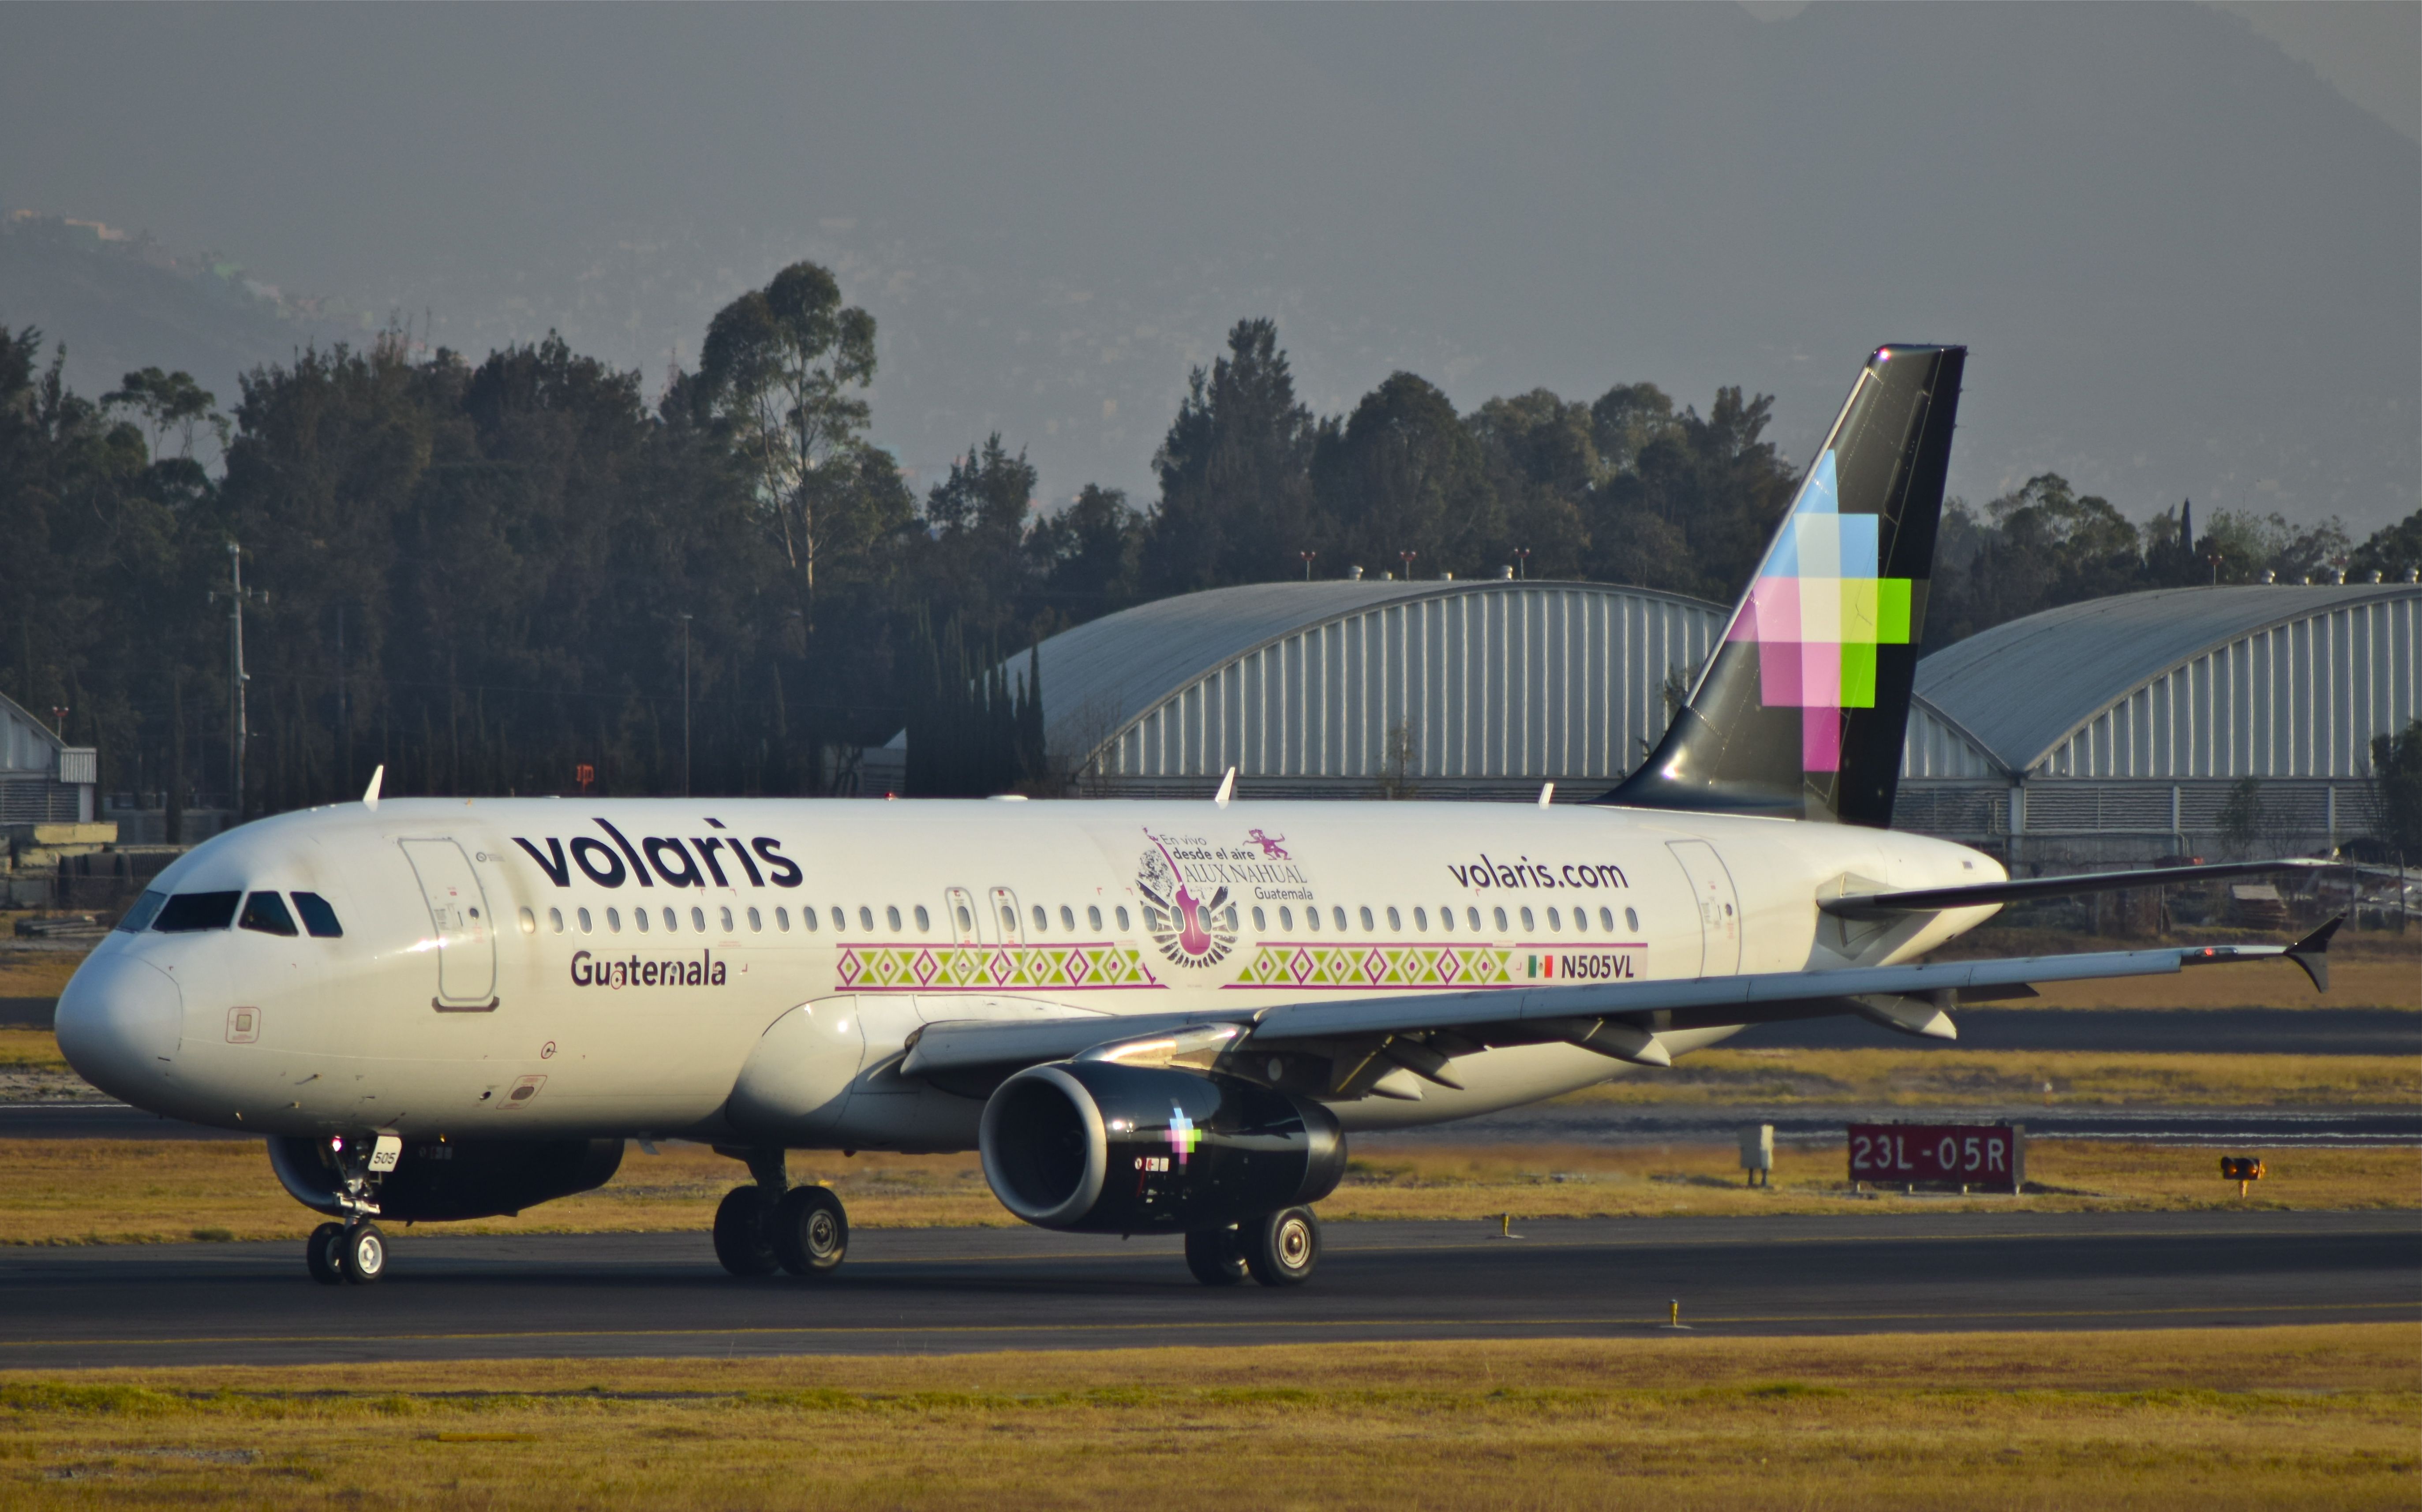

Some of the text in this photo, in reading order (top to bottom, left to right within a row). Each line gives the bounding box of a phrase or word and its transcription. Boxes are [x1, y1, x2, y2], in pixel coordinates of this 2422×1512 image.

[1160, 835, 1206, 845] En vivo
[510, 818, 804, 889] volaris
[1173, 848, 1255, 860] desde el aire
[1184, 865, 1307, 883] ALUX NAHUAL
[1447, 854, 1628, 888] volaris.com
[1254, 887, 1313, 900] Guatemala
[571, 948, 726, 986] Guatemala
[1561, 955, 1634, 978] N505VL
[374, 1153, 395, 1164] 505
